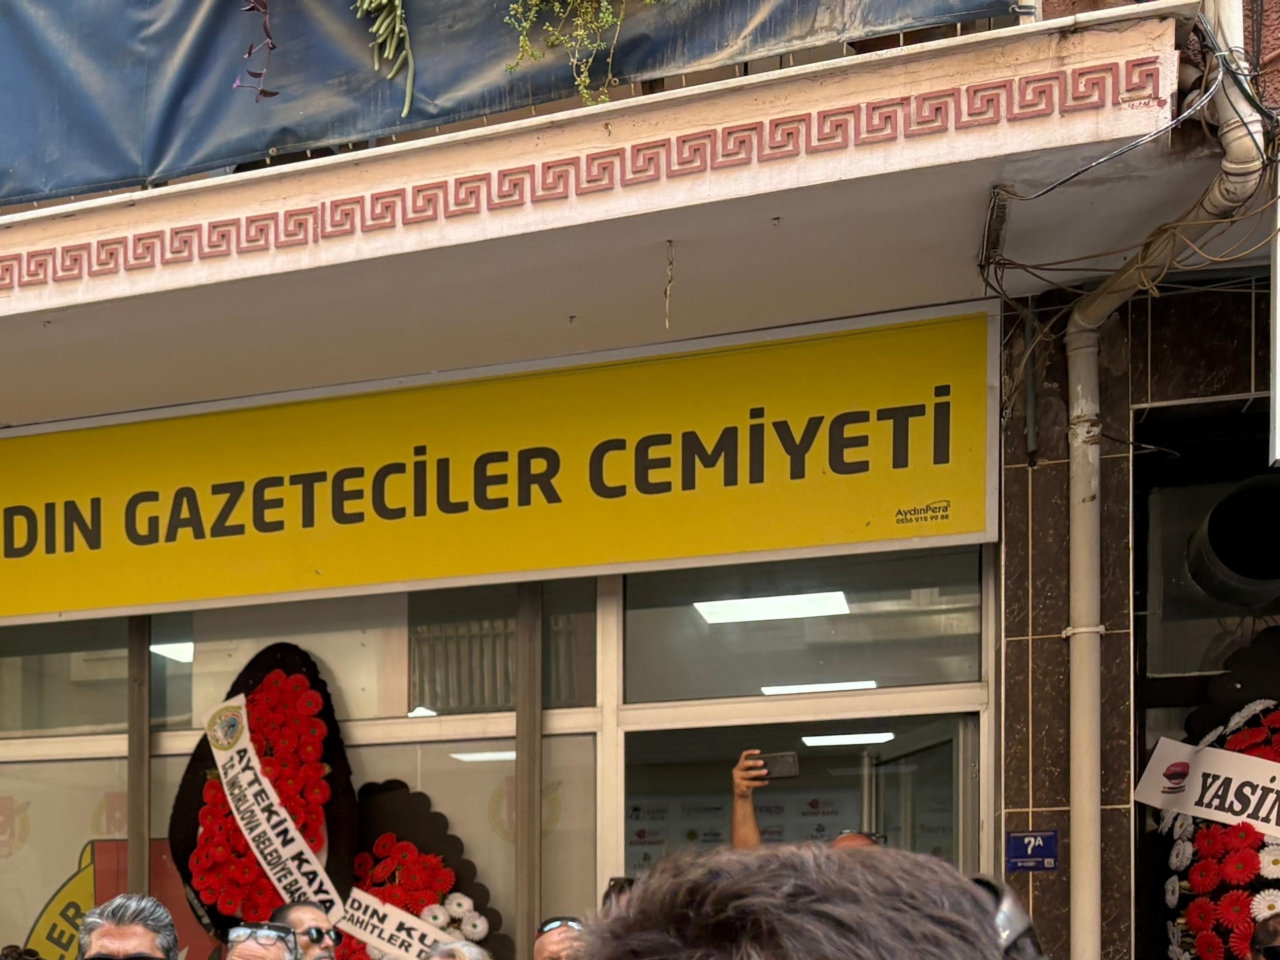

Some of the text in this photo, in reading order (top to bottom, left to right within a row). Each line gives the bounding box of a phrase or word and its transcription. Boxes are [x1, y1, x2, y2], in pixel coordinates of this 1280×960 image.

[124, 445, 562, 546] GAZETECİLER
[589, 384, 951, 498] CEMİYETİ
[235, 747, 336, 914] AYTEKİN KAYA
